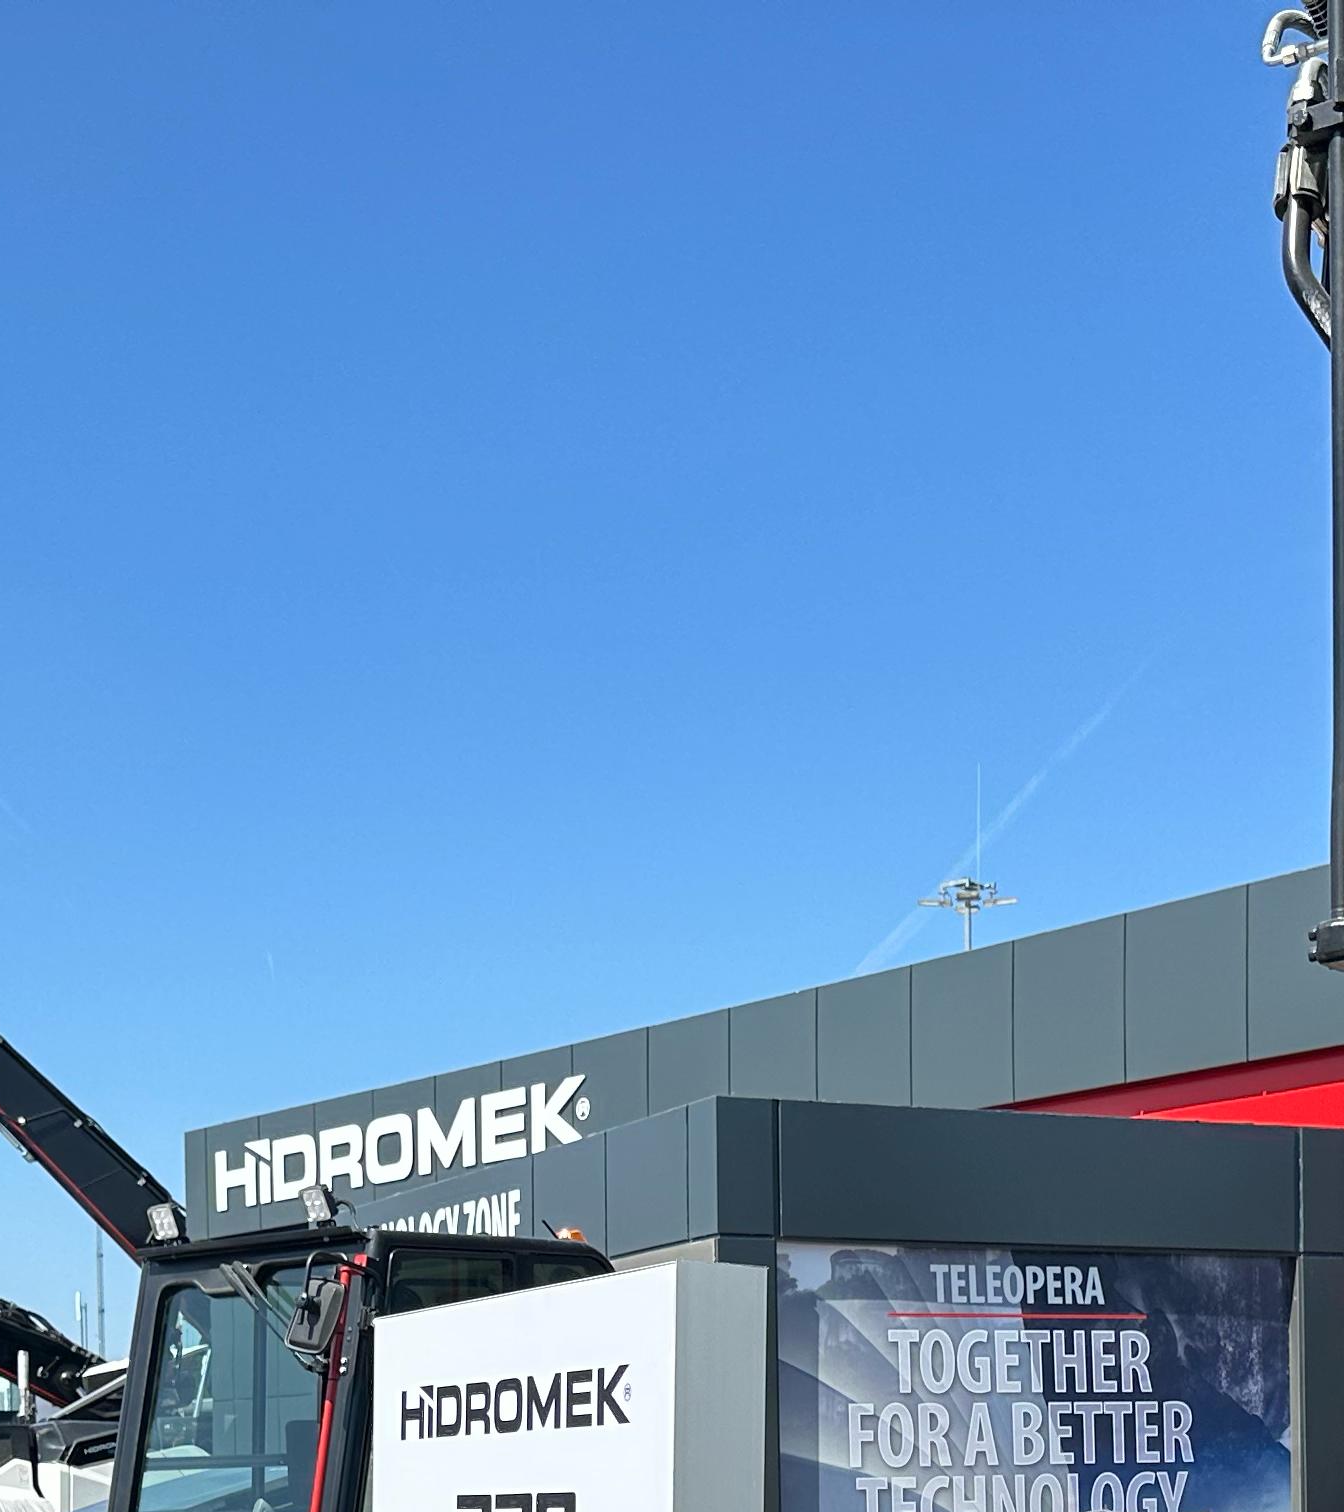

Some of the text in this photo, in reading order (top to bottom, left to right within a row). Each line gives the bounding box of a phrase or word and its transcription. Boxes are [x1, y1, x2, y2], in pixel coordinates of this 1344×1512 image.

[930, 1264, 1105, 1306] TELEOPERA
[887, 1328, 1153, 1394] TOGETHER
[848, 1400, 1194, 1468] FOR A BETTER
